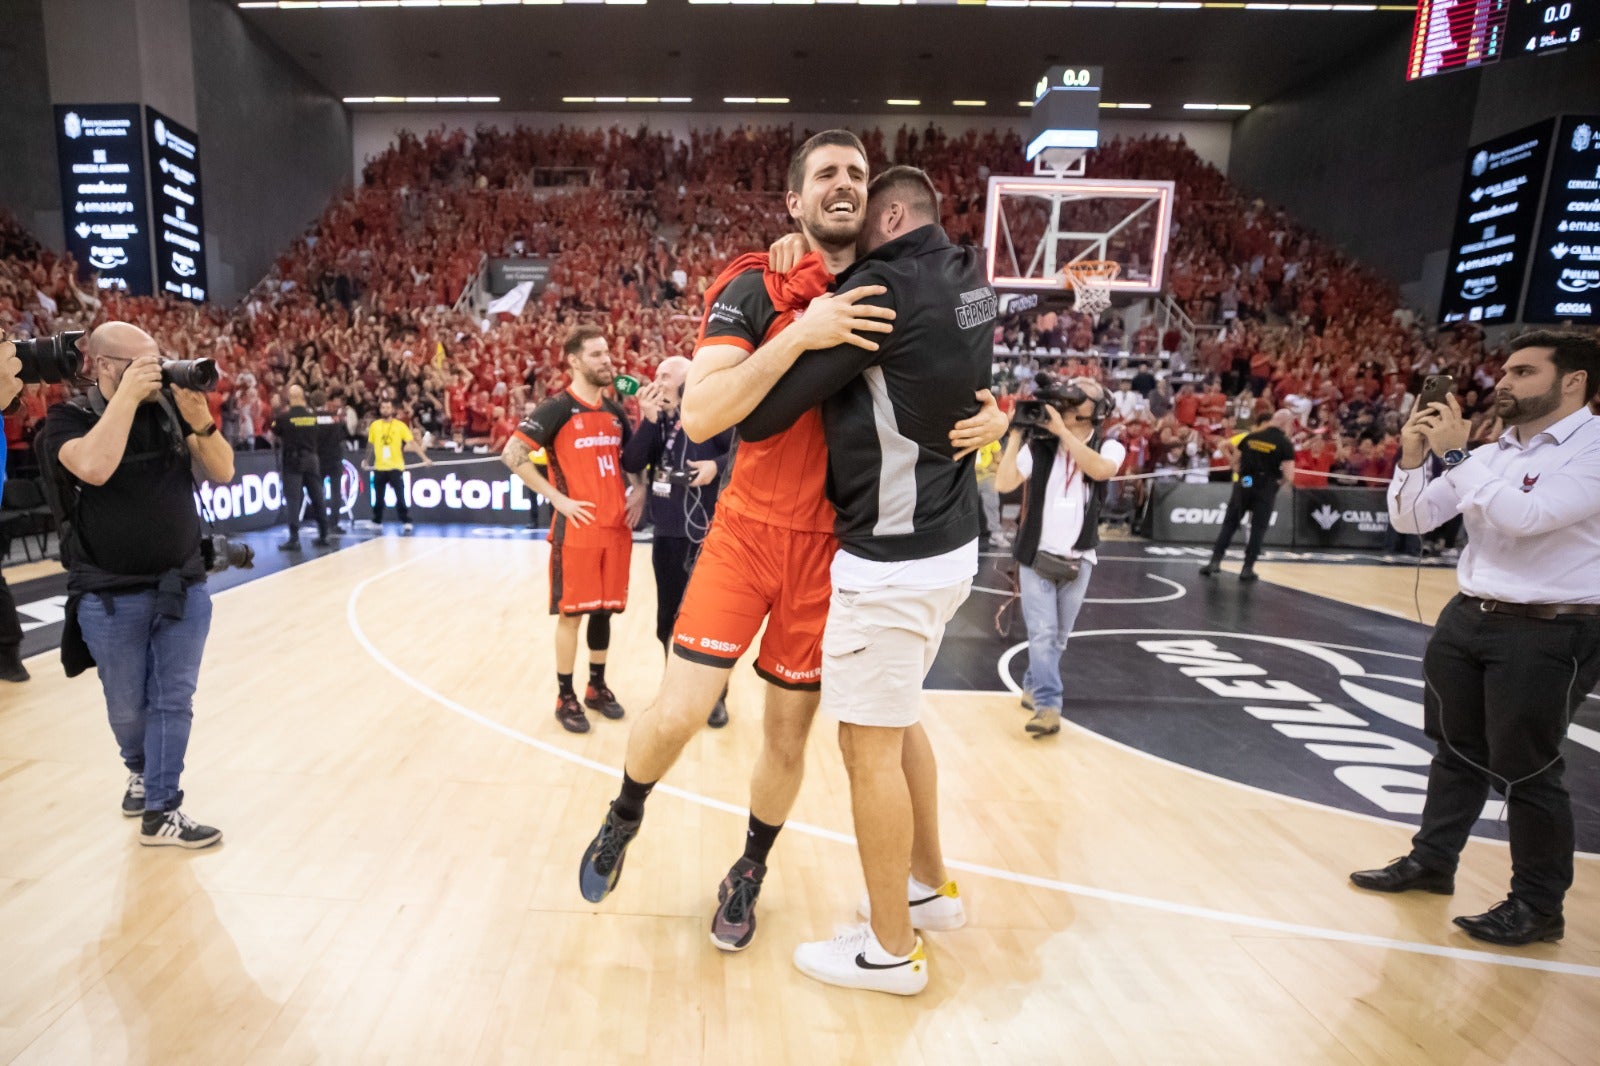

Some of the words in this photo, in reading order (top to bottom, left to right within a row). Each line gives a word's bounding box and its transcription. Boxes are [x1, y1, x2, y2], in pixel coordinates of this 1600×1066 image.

[1544, 2, 1572, 23] 0.0
[1526, 36, 1536, 50] 4
[1063, 69, 1090, 86] 0.0
[597, 454, 616, 477] 14
